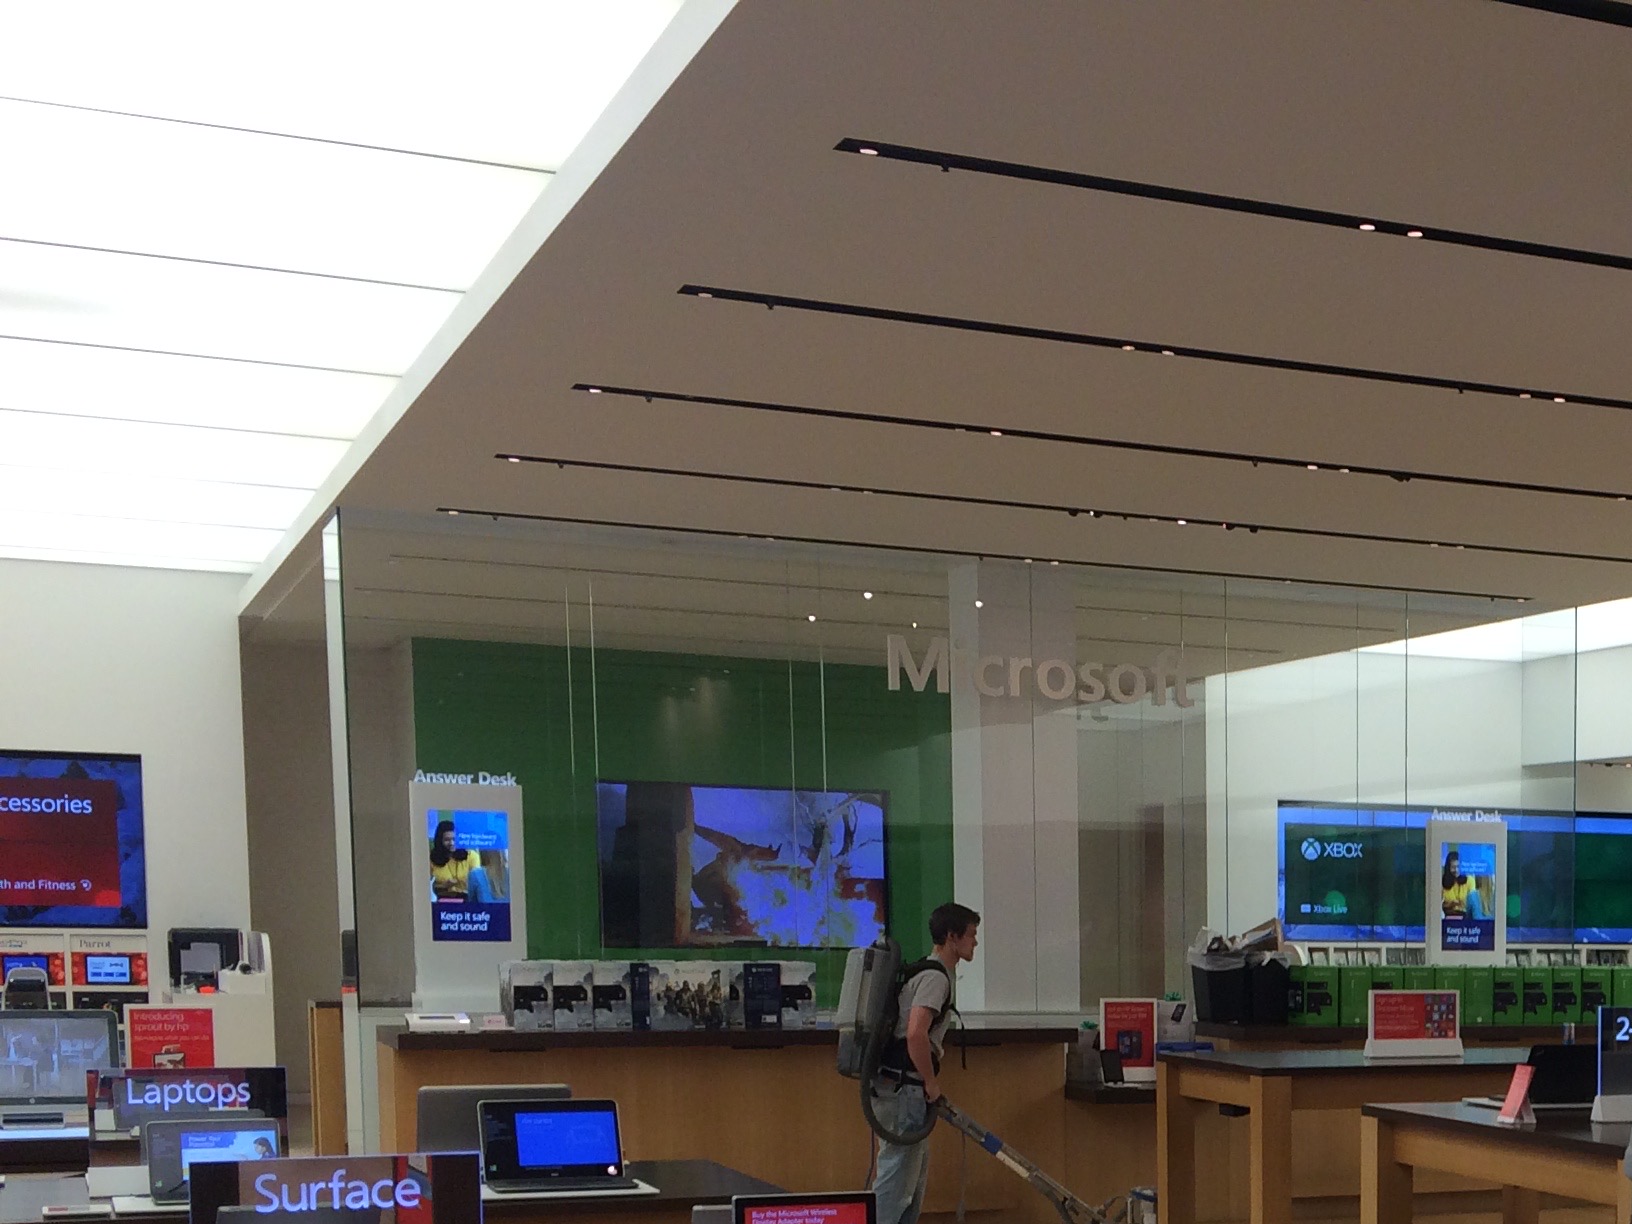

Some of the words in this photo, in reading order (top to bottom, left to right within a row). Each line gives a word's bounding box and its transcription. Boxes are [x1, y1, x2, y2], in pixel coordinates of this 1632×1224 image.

[886, 634, 1195, 708] Mcrosoft
[414, 769, 474, 785] Answer
[478, 771, 517, 787] Desk
[1431, 808, 1472, 821] Answer
[1475, 810, 1502, 822] Desk
[1323, 842, 1363, 858] XBOX
[14, 880, 35, 890] and
[38, 879, 76, 891] Fitness
[1313, 904, 1332, 914] Xbox
[1333, 904, 1348, 914] Live
[440, 912, 463, 923] Keep
[464, 911, 471, 922] it
[472, 911, 491, 922] safe
[441, 922, 458, 931] and
[460, 922, 488, 932] sound
[1446, 926, 1461, 936] Keep
[80, 940, 111, 948] Parrot
[1446, 935, 1459, 943] and
[1460, 935, 1479, 944] sound
[134, 1011, 185, 1023] Introducing
[134, 1022, 163, 1032] sprout
[164, 1022, 175, 1032] by
[176, 1022, 189, 1032] hp
[126, 1077, 251, 1112] Laptops
[255, 1168, 421, 1214] Surface
[752, 1210, 764, 1220] Buy
[766, 1210, 777, 1218] the
[778, 1209, 809, 1218] Microsoft
[810, 1208, 837, 1217] Wireless
